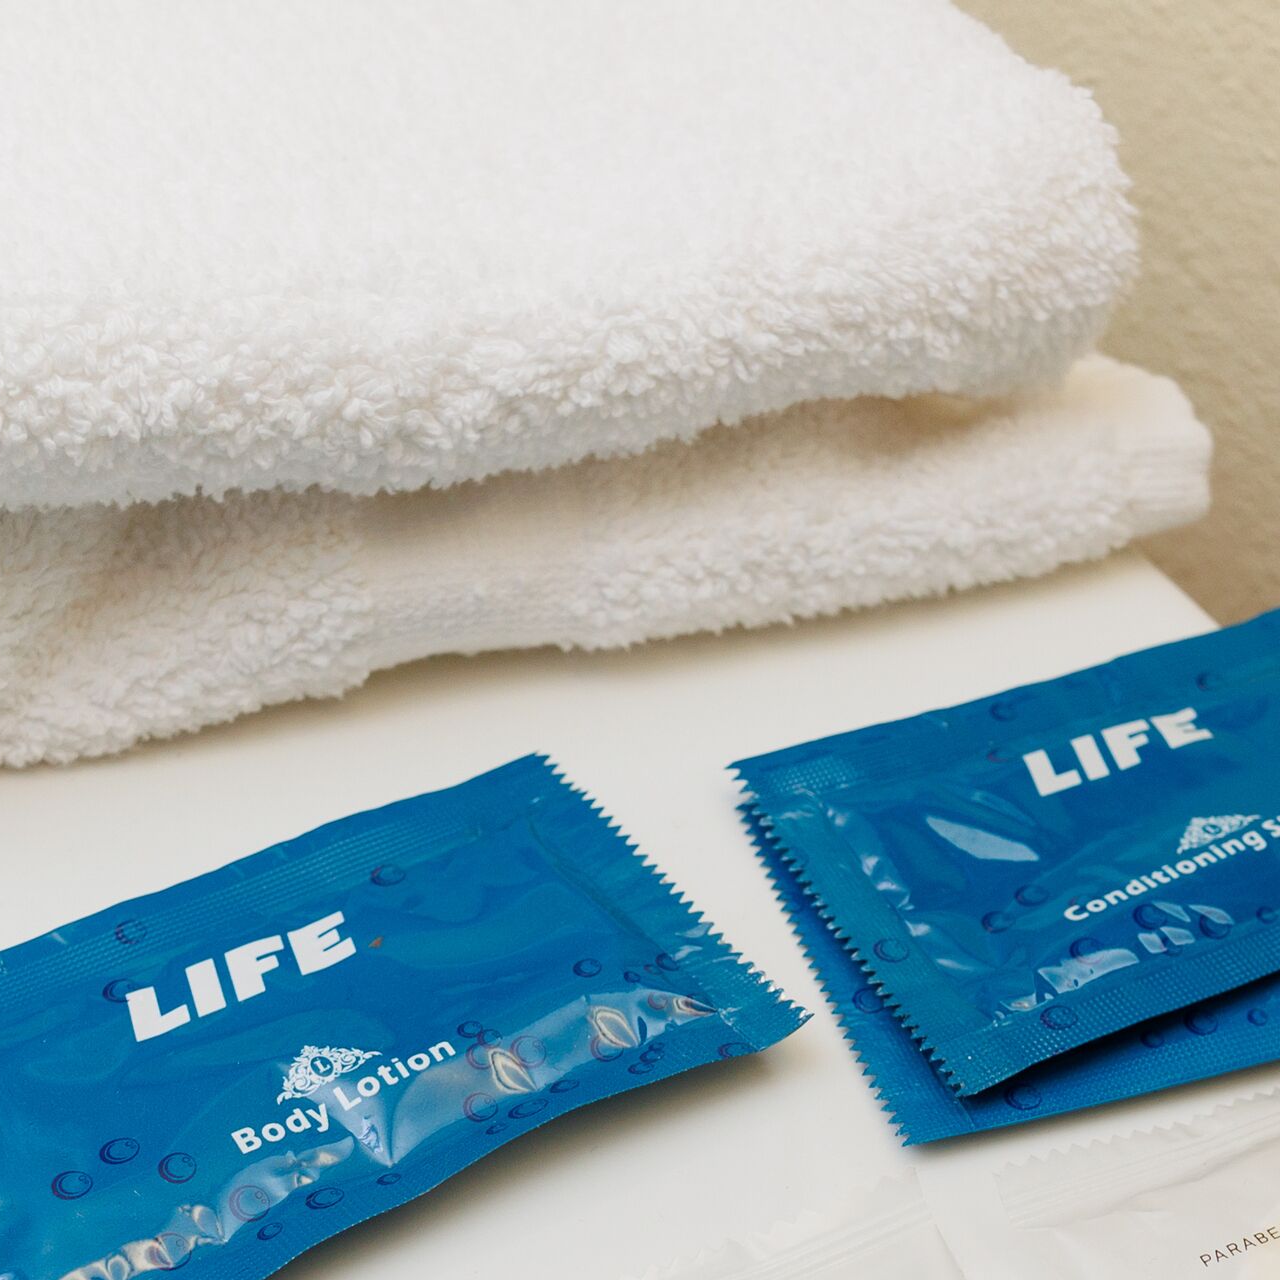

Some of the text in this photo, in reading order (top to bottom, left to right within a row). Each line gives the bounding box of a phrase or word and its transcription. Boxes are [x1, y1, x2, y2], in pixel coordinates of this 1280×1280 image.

[1023, 707, 1213, 797] LIFE
[1064, 828, 1267, 921] Conditioning
[126, 911, 356, 1042] LIFE
[231, 1040, 456, 1154] Body Lotion
[314, 1058, 330, 1073] L
